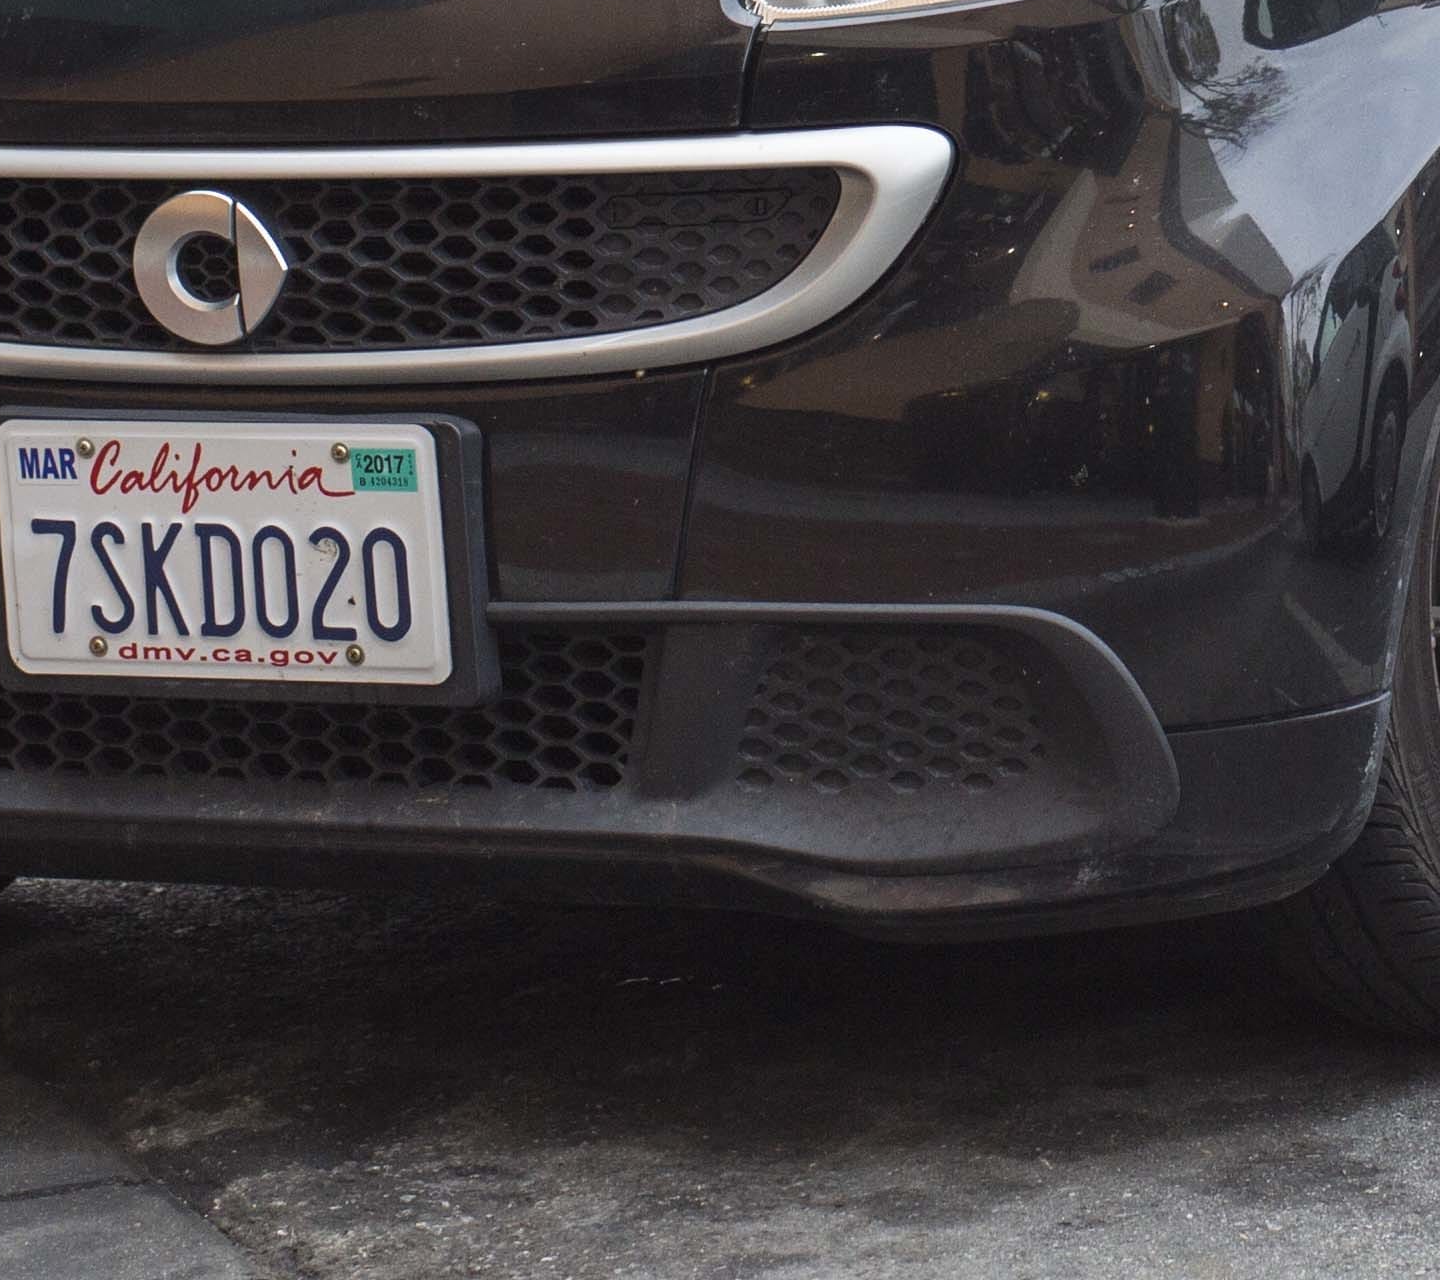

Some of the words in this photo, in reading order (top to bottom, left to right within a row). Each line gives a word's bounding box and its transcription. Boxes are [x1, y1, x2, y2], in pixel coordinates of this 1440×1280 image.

[18, 446, 79, 481] MAR
[89, 439, 356, 514] California
[363, 453, 404, 474] 2017
[30, 517, 413, 643] 7SKD020
[117, 641, 339, 669] dmv.ca.gov
